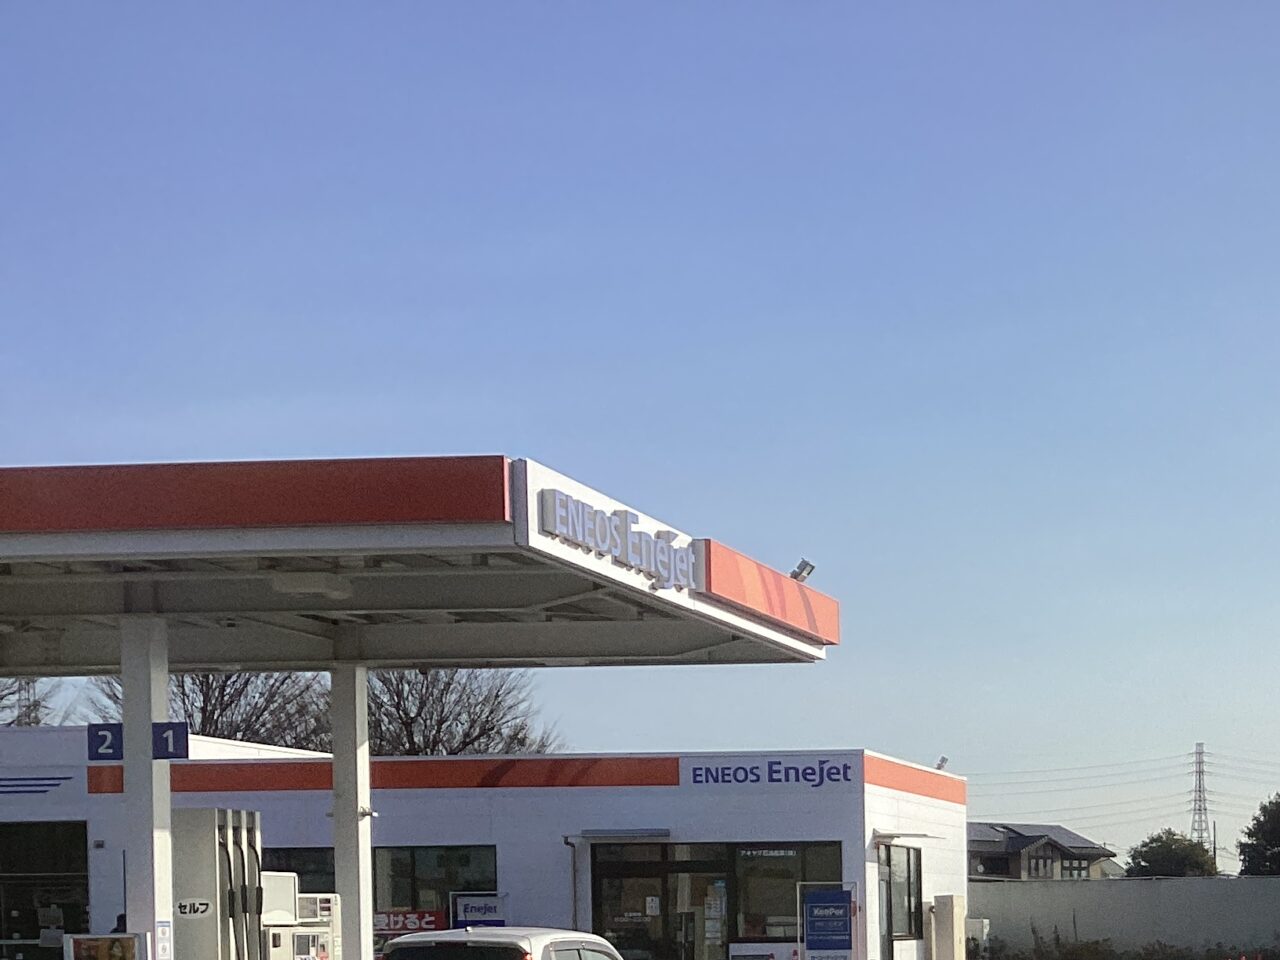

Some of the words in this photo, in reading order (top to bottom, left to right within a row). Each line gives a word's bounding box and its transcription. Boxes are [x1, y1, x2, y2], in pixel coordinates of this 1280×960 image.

[554, 491, 622, 559] ENEOS
[626, 510, 697, 591] Enejet
[97, 730, 114, 754] 2
[161, 729, 175, 753] 1
[692, 766, 760, 784] ENEOS
[766, 759, 852, 788] Enejet
[177, 902, 211, 916] セルフ
